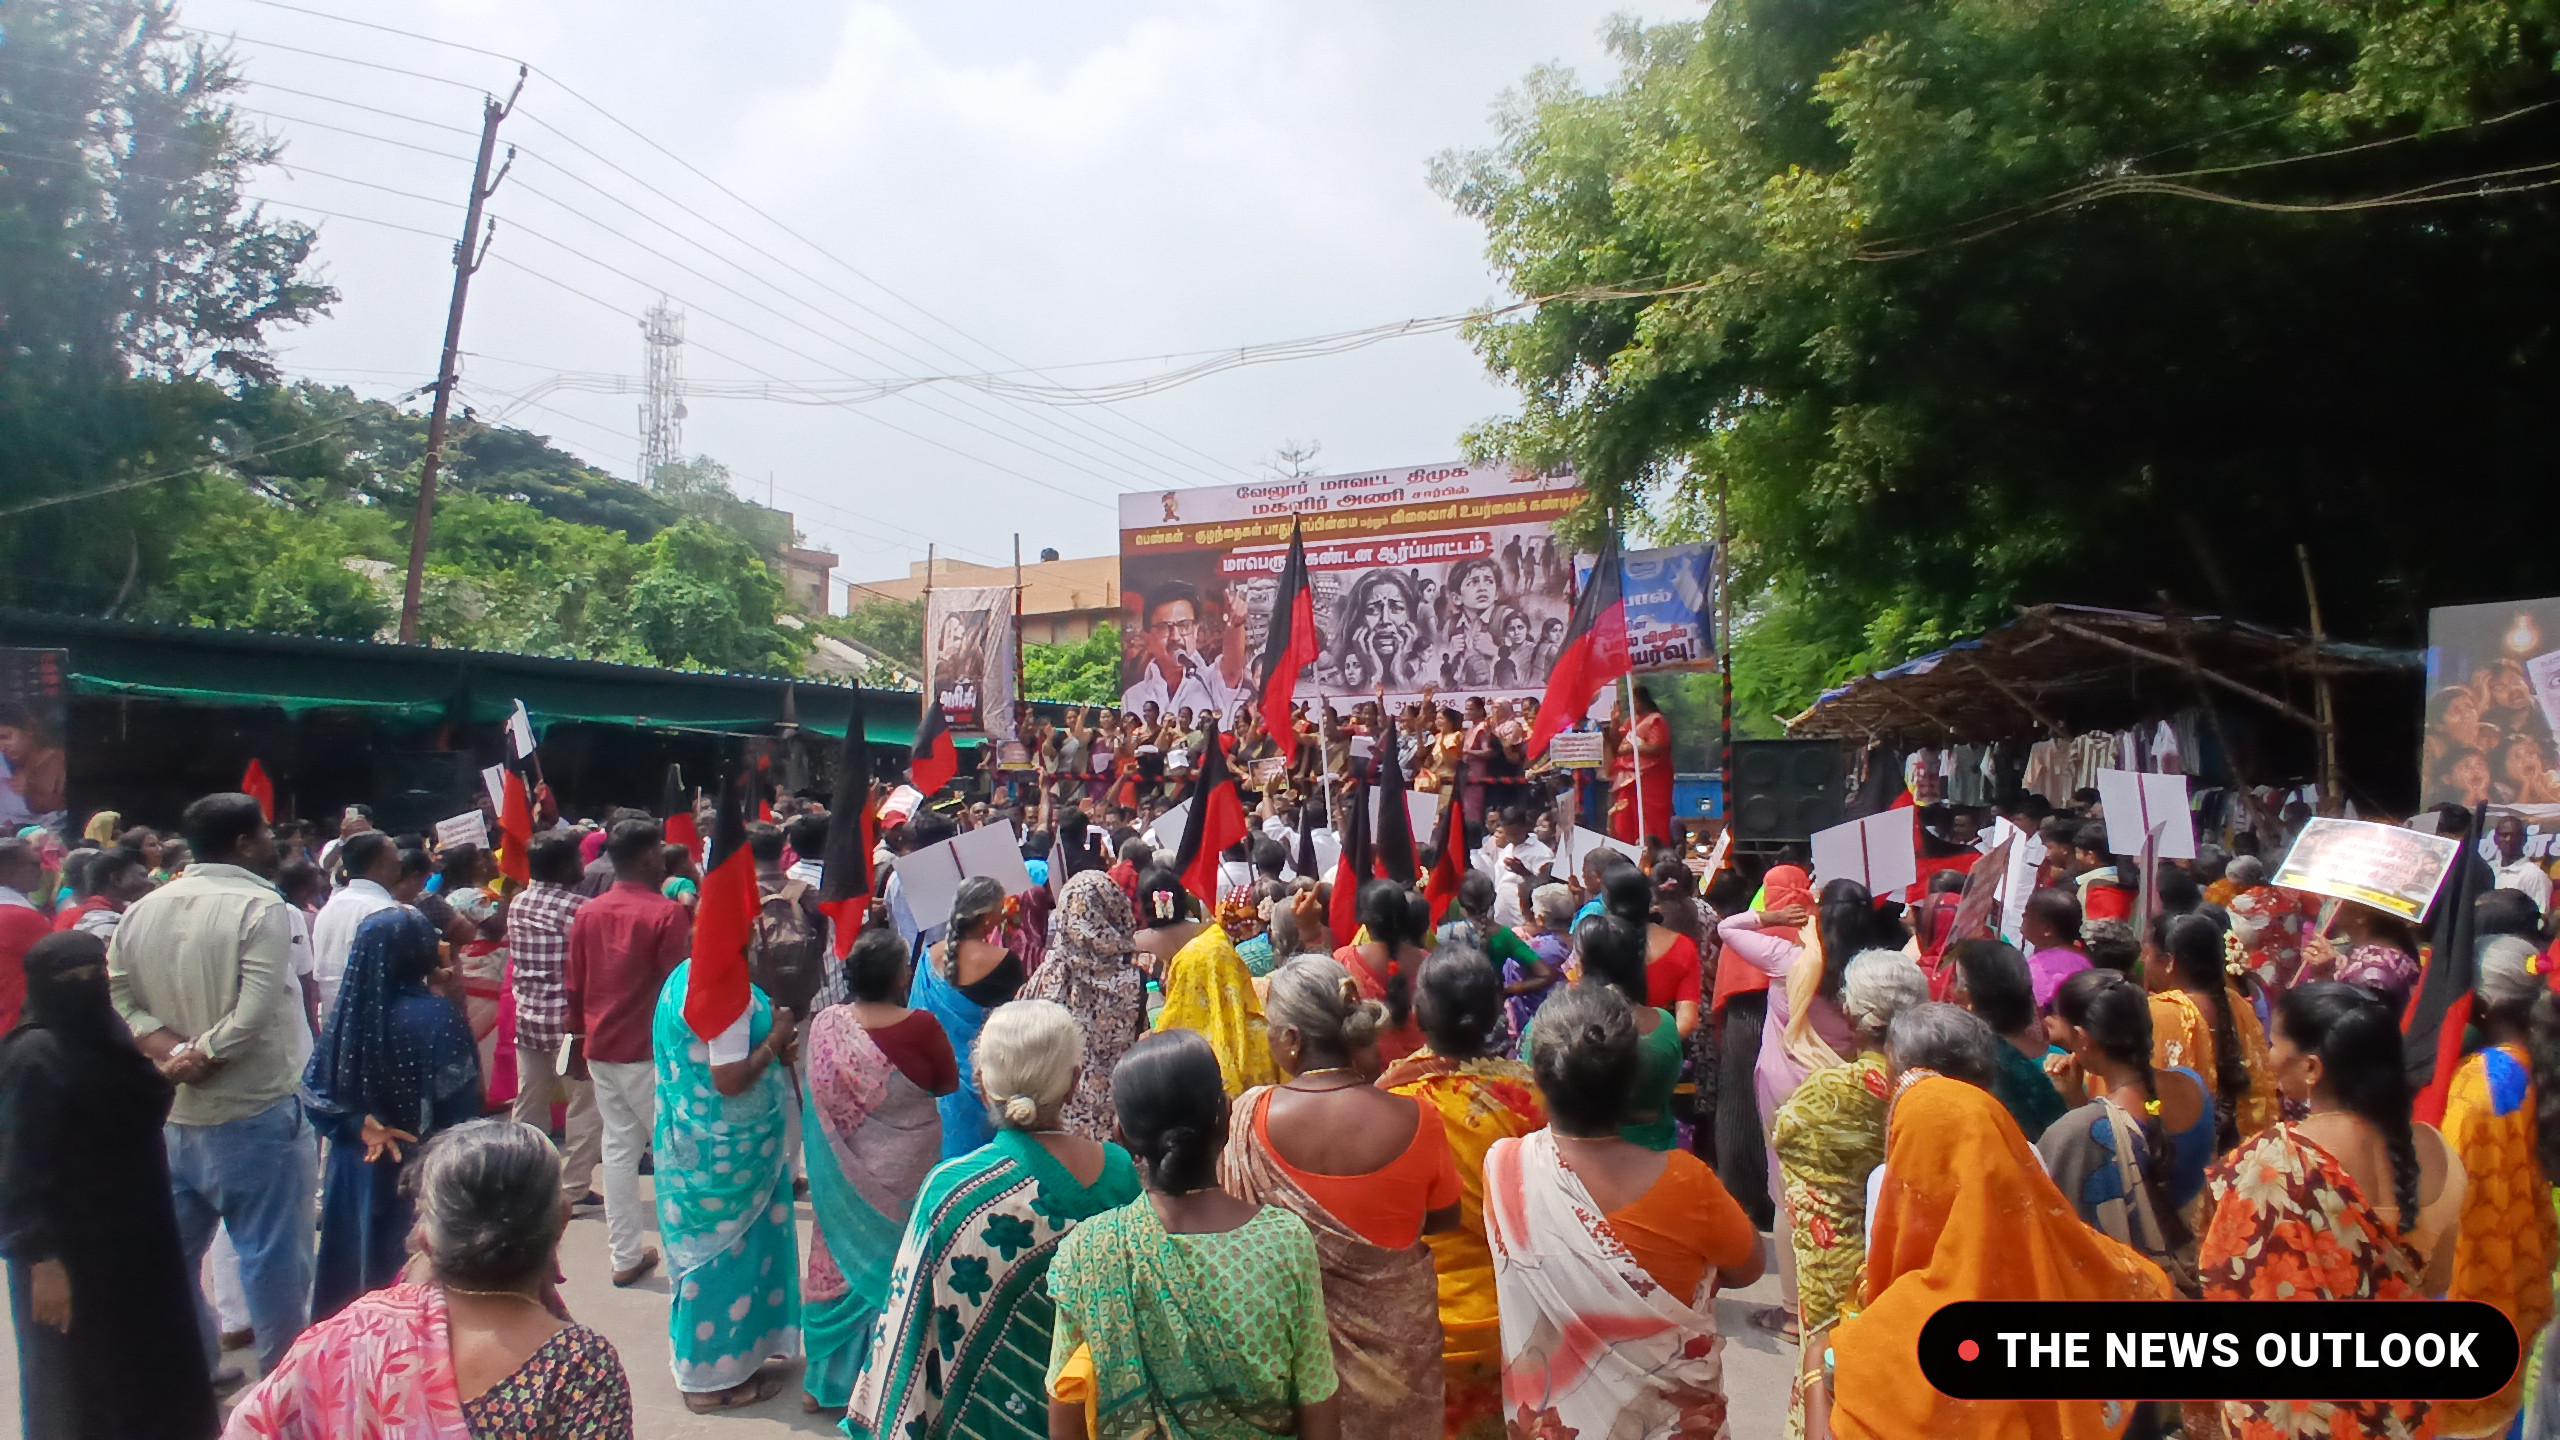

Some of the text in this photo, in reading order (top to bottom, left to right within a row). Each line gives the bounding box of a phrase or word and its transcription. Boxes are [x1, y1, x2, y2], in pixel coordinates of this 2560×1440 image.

[1236, 467, 1469, 500] வேலூர் மாவட்ட திமுக
[1252, 485, 1470, 515] மகளிர் அணி சார்பில்
[1135, 529, 1184, 546] பெண்கள்
[1195, 522, 1262, 545] குழந்தைகள்
[1390, 504, 1457, 524] விலைவாசி
[1460, 498, 1527, 519] உயர்வைக்
[1304, 547, 1373, 567] கண்டன
[1377, 535, 1485, 564] ஆர்ப்பாட்டம்
